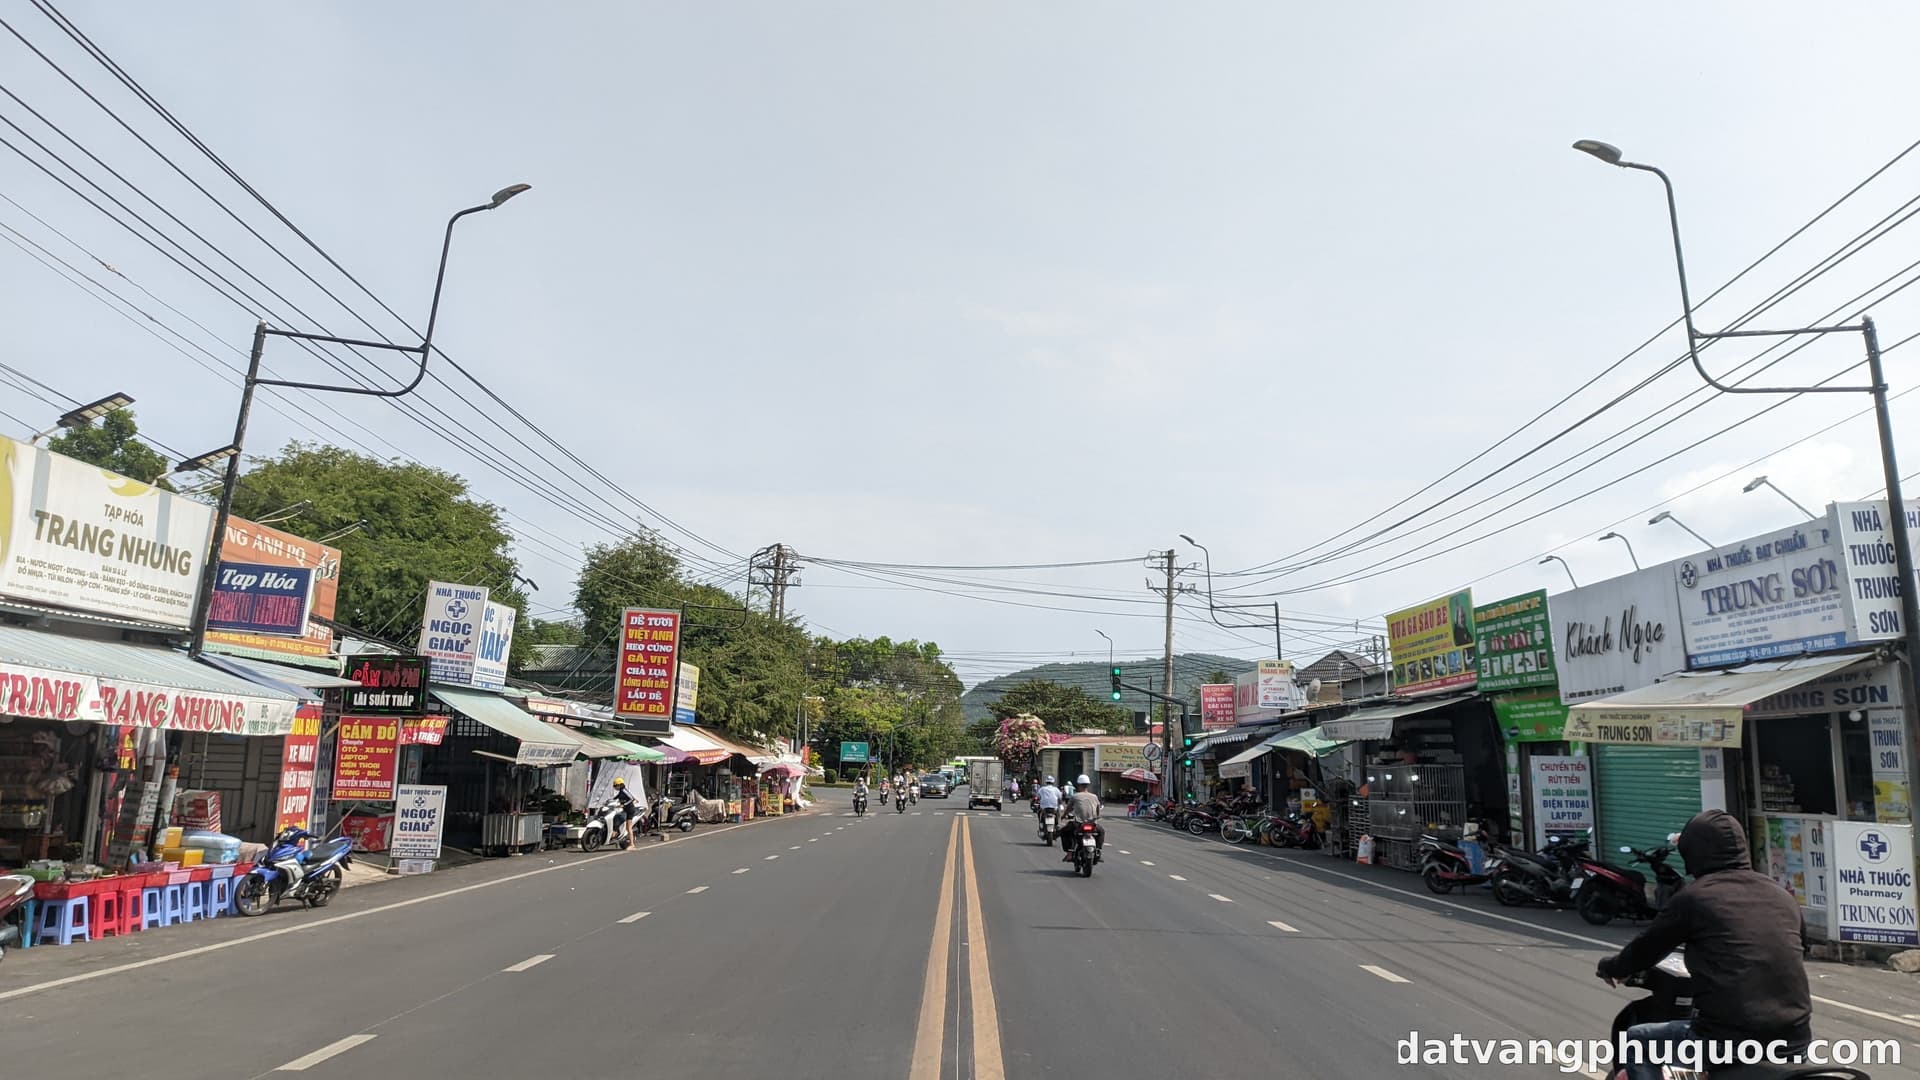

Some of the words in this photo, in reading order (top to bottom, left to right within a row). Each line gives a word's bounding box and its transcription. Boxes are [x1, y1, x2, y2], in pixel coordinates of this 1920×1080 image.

[104, 504, 122, 522] TẠP
[124, 510, 144, 527] HÓA
[1852, 505, 1882, 532] NHÀ
[35, 510, 115, 557] TRANG
[118, 534, 192, 576] NHUNG
[1849, 535, 1896, 565] THUỐC
[1707, 554, 1722, 572] NHÀ
[222, 569, 258, 590] Tạp
[260, 573, 298, 590] Hóa
[1855, 576, 1902, 600] TRUNG
[436, 588, 452, 597] NHÀ
[1702, 572, 1784, 616] TRUNG
[430, 620, 472, 636] NGỌC
[1869, 609, 1899, 633] SƠN
[428, 636, 465, 652] GIÀU
[651, 630, 674, 641] ANH
[1566, 616, 1612, 662] Khánh
[1619, 605, 1663, 664] Ngọc
[626, 643, 644, 651] HEO
[650, 655, 668, 666] VỊT
[648, 668, 667, 678] LỤA
[1833, 684, 1888, 705] SƠN
[101, 686, 167, 728] RANG
[169, 695, 244, 732] NHUNG
[648, 702, 665, 713] BÒ
[305, 716, 320, 736] BÁN
[1597, 725, 1630, 740] TRUNG
[1633, 724, 1652, 742] SƠN
[288, 745, 298, 762] XE
[298, 742, 314, 763] MÁY
[1880, 751, 1898, 768] SƠN
[283, 795, 308, 814] LAPTOP
[1543, 799, 1562, 810] ĐIỆN
[1565, 800, 1589, 810] THOẠI
[1551, 812, 1582, 820] LAPTOP
[1840, 867, 1865, 885] NHÀ
[1869, 868, 1911, 887] THUỐC
[1850, 888, 1903, 900] Pharmacy
[1840, 904, 1885, 924] TRUNG
[1889, 906, 1915, 925] SƠN
